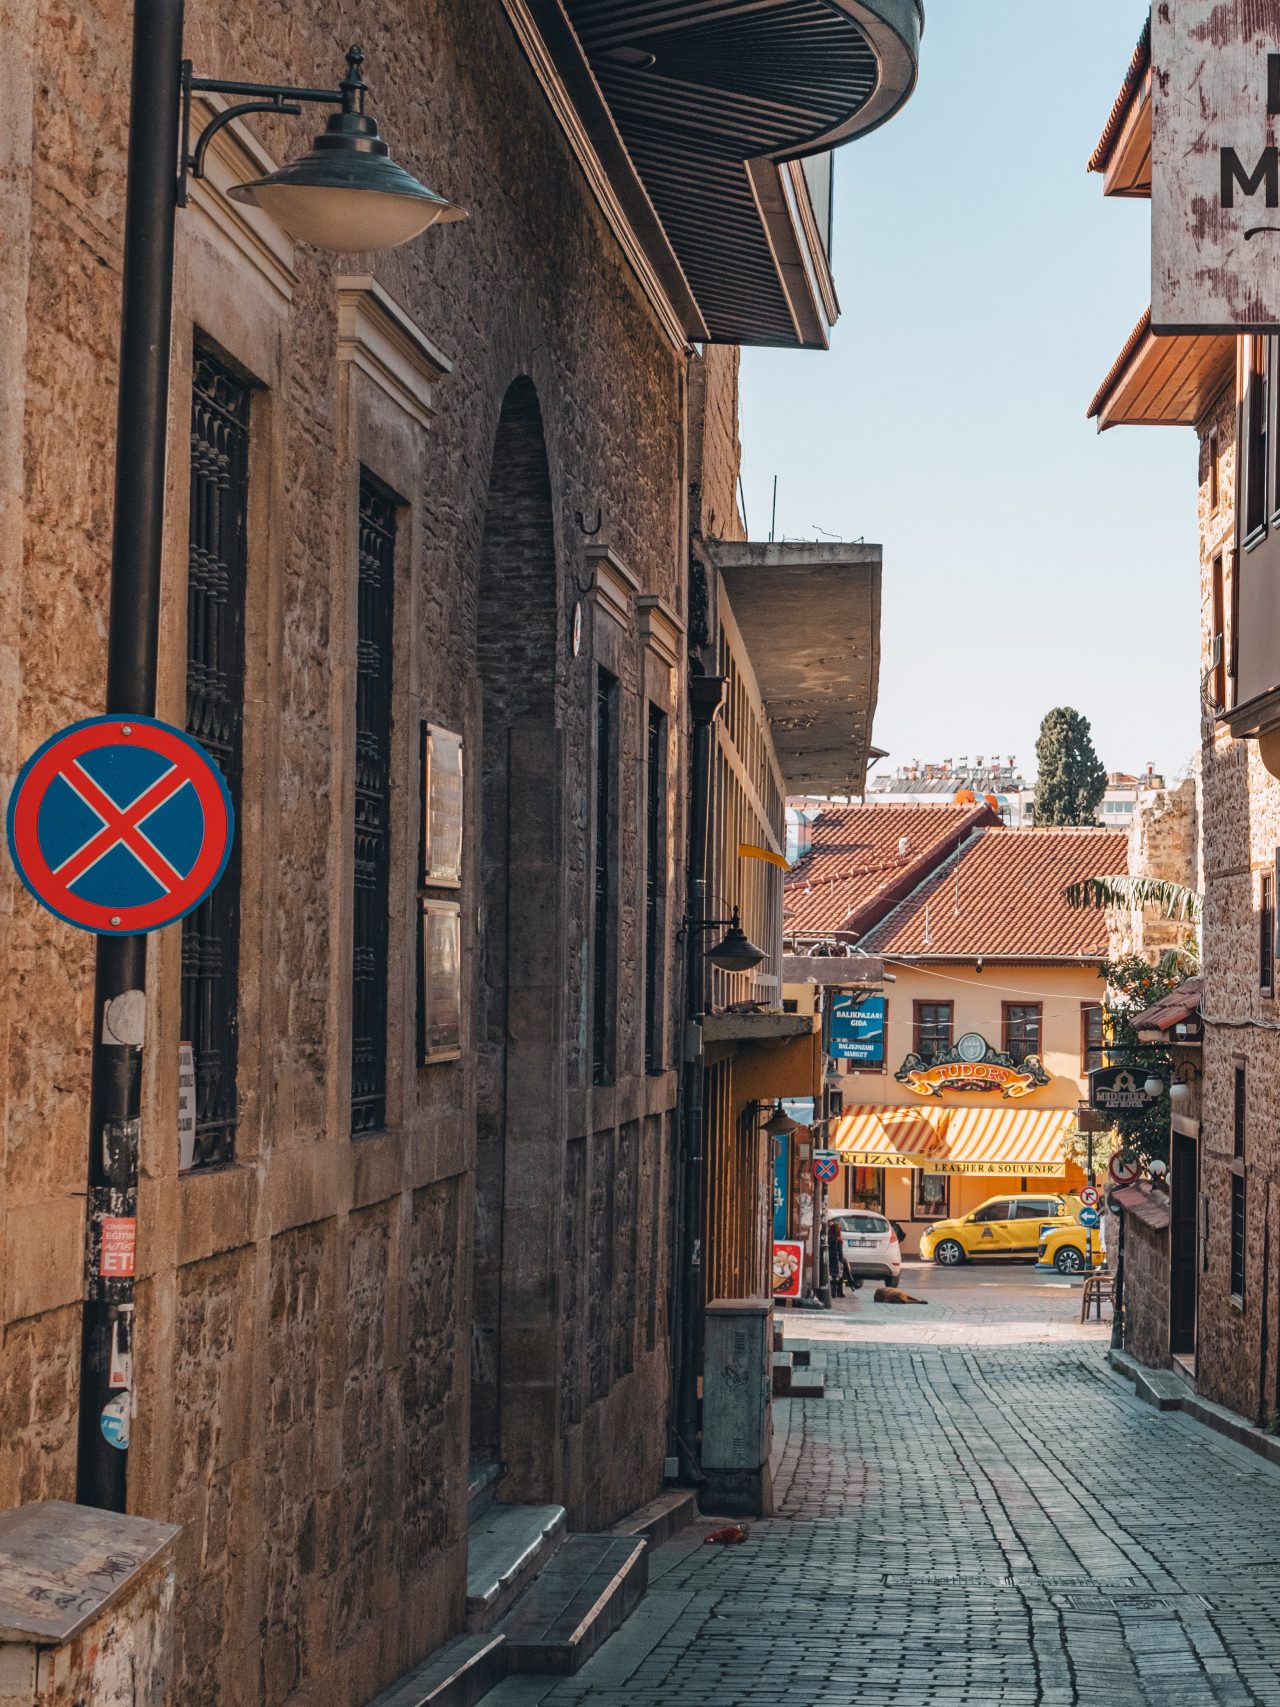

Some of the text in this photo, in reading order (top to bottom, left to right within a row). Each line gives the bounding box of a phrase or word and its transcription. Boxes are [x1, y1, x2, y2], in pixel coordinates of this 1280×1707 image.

[836, 1010, 883, 1019] BALIKPAZARI
[850, 1019, 868, 1027] GIDA
[935, 1064, 1009, 1083] TUDORS
[934, 1163, 1054, 1174] LEATHER & SOUVENIR
[103, 1252, 134, 1270] ET!
